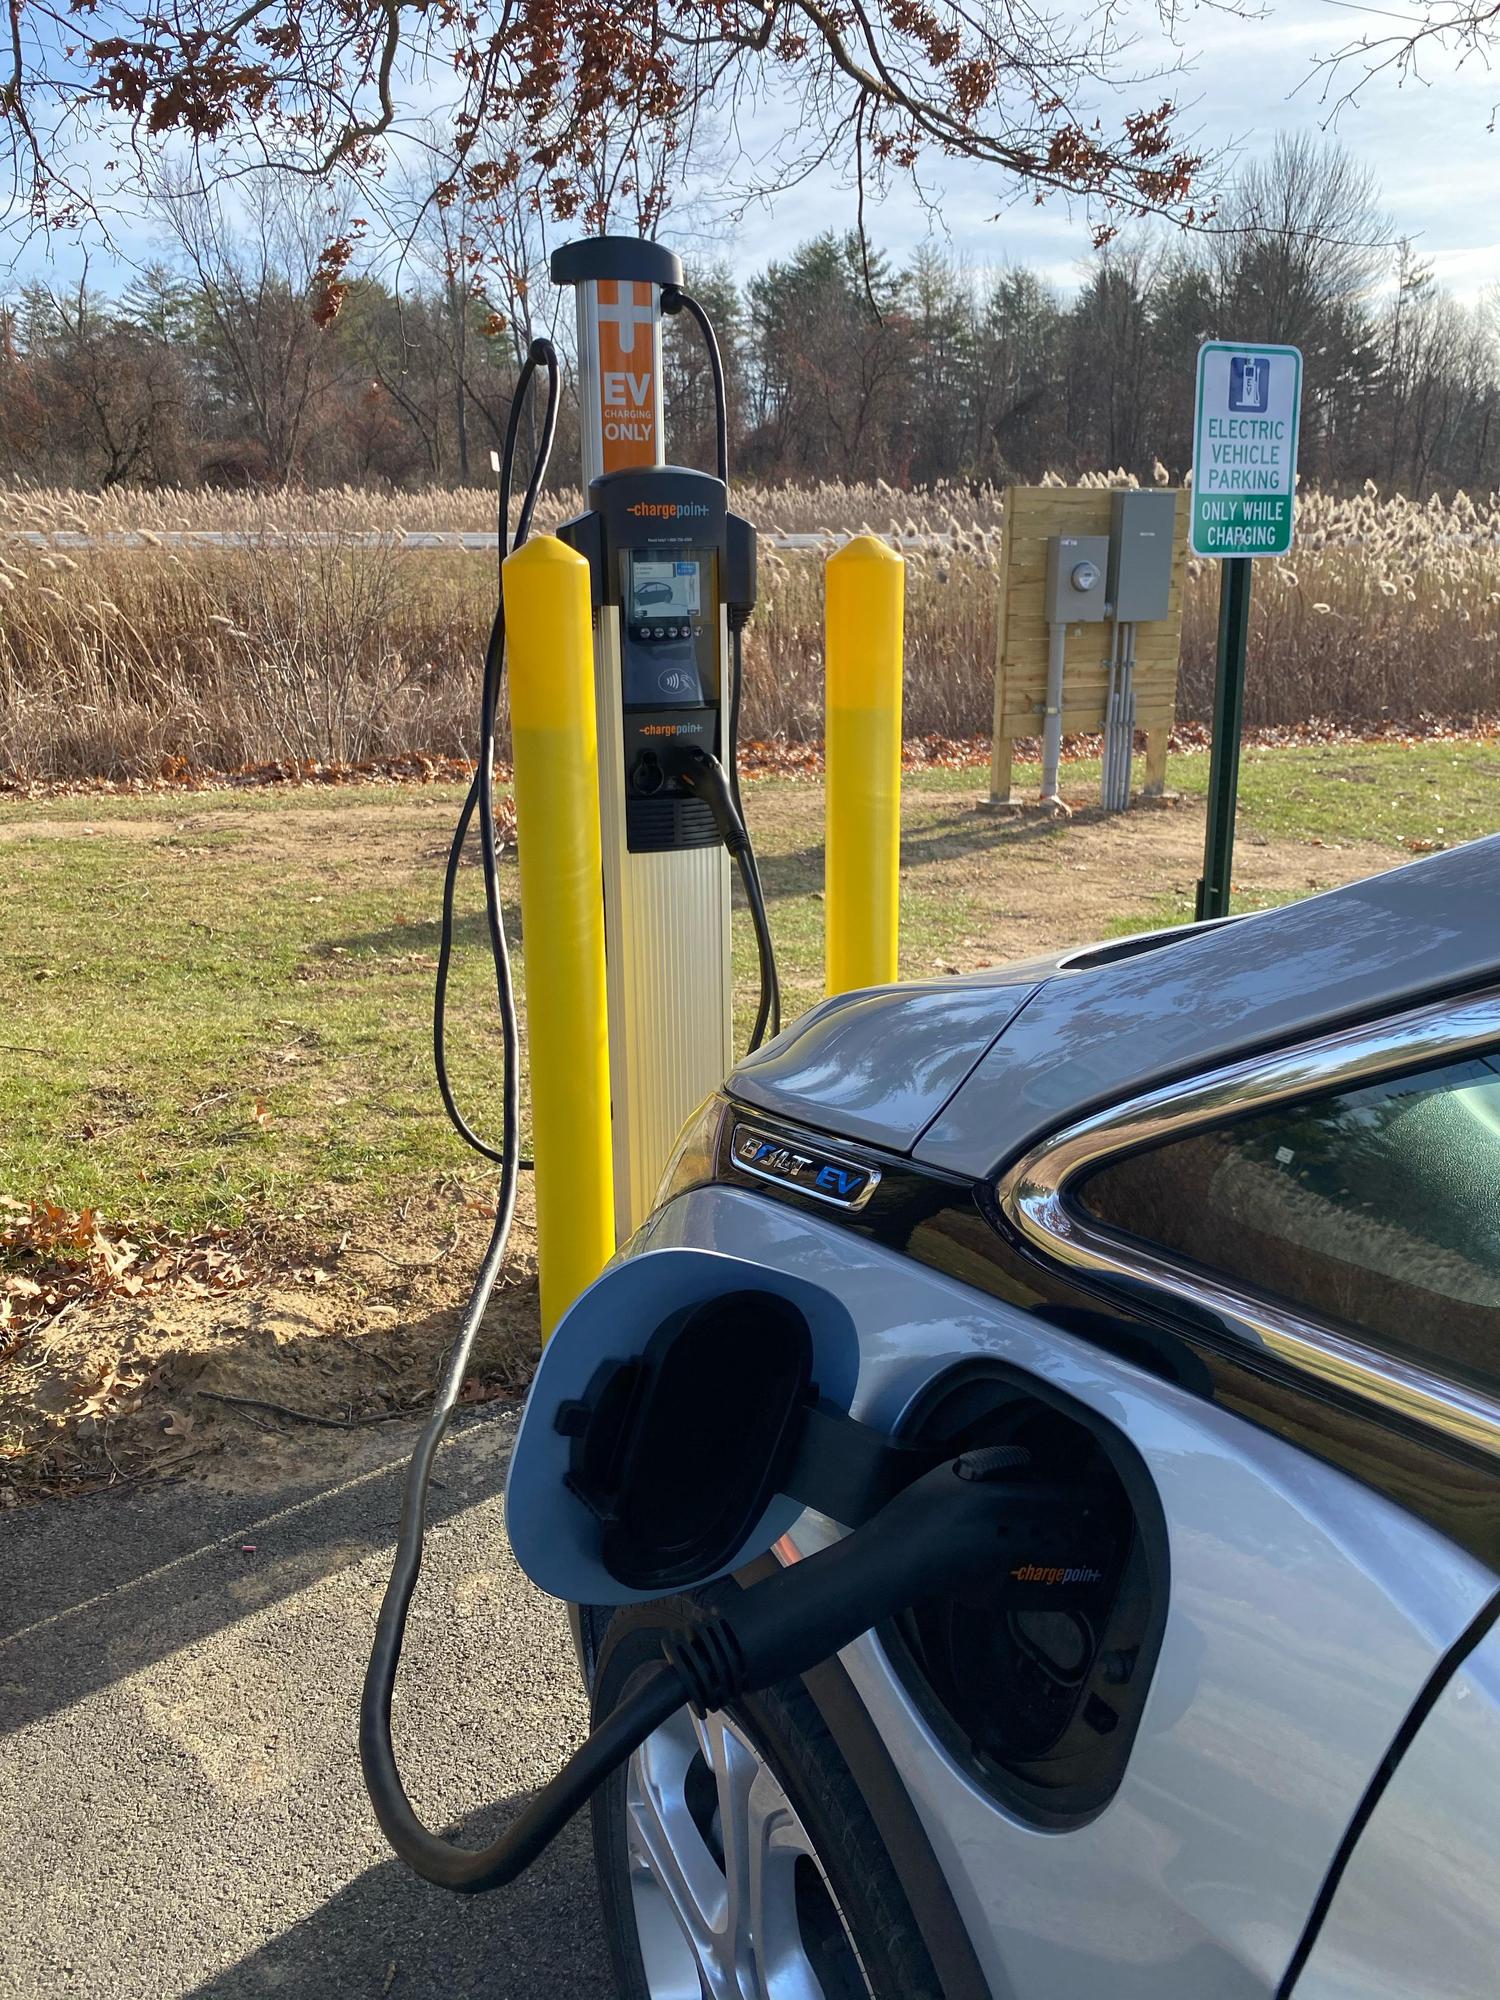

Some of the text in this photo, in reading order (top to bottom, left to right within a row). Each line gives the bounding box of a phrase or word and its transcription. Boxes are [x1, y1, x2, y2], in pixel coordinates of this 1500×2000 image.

[604, 372, 651, 406] EV
[604, 409, 652, 419] CHARGING
[604, 423, 653, 441] ONLY
[1208, 418, 1285, 440] ELECTRIC
[1211, 443, 1280, 465] VEHICLE
[1208, 469, 1280, 489] PARKING
[1202, 501, 1284, 521] ONLY WHILE
[1207, 526, 1276, 546] CHARGING
[815, 1165, 865, 1194] EV
